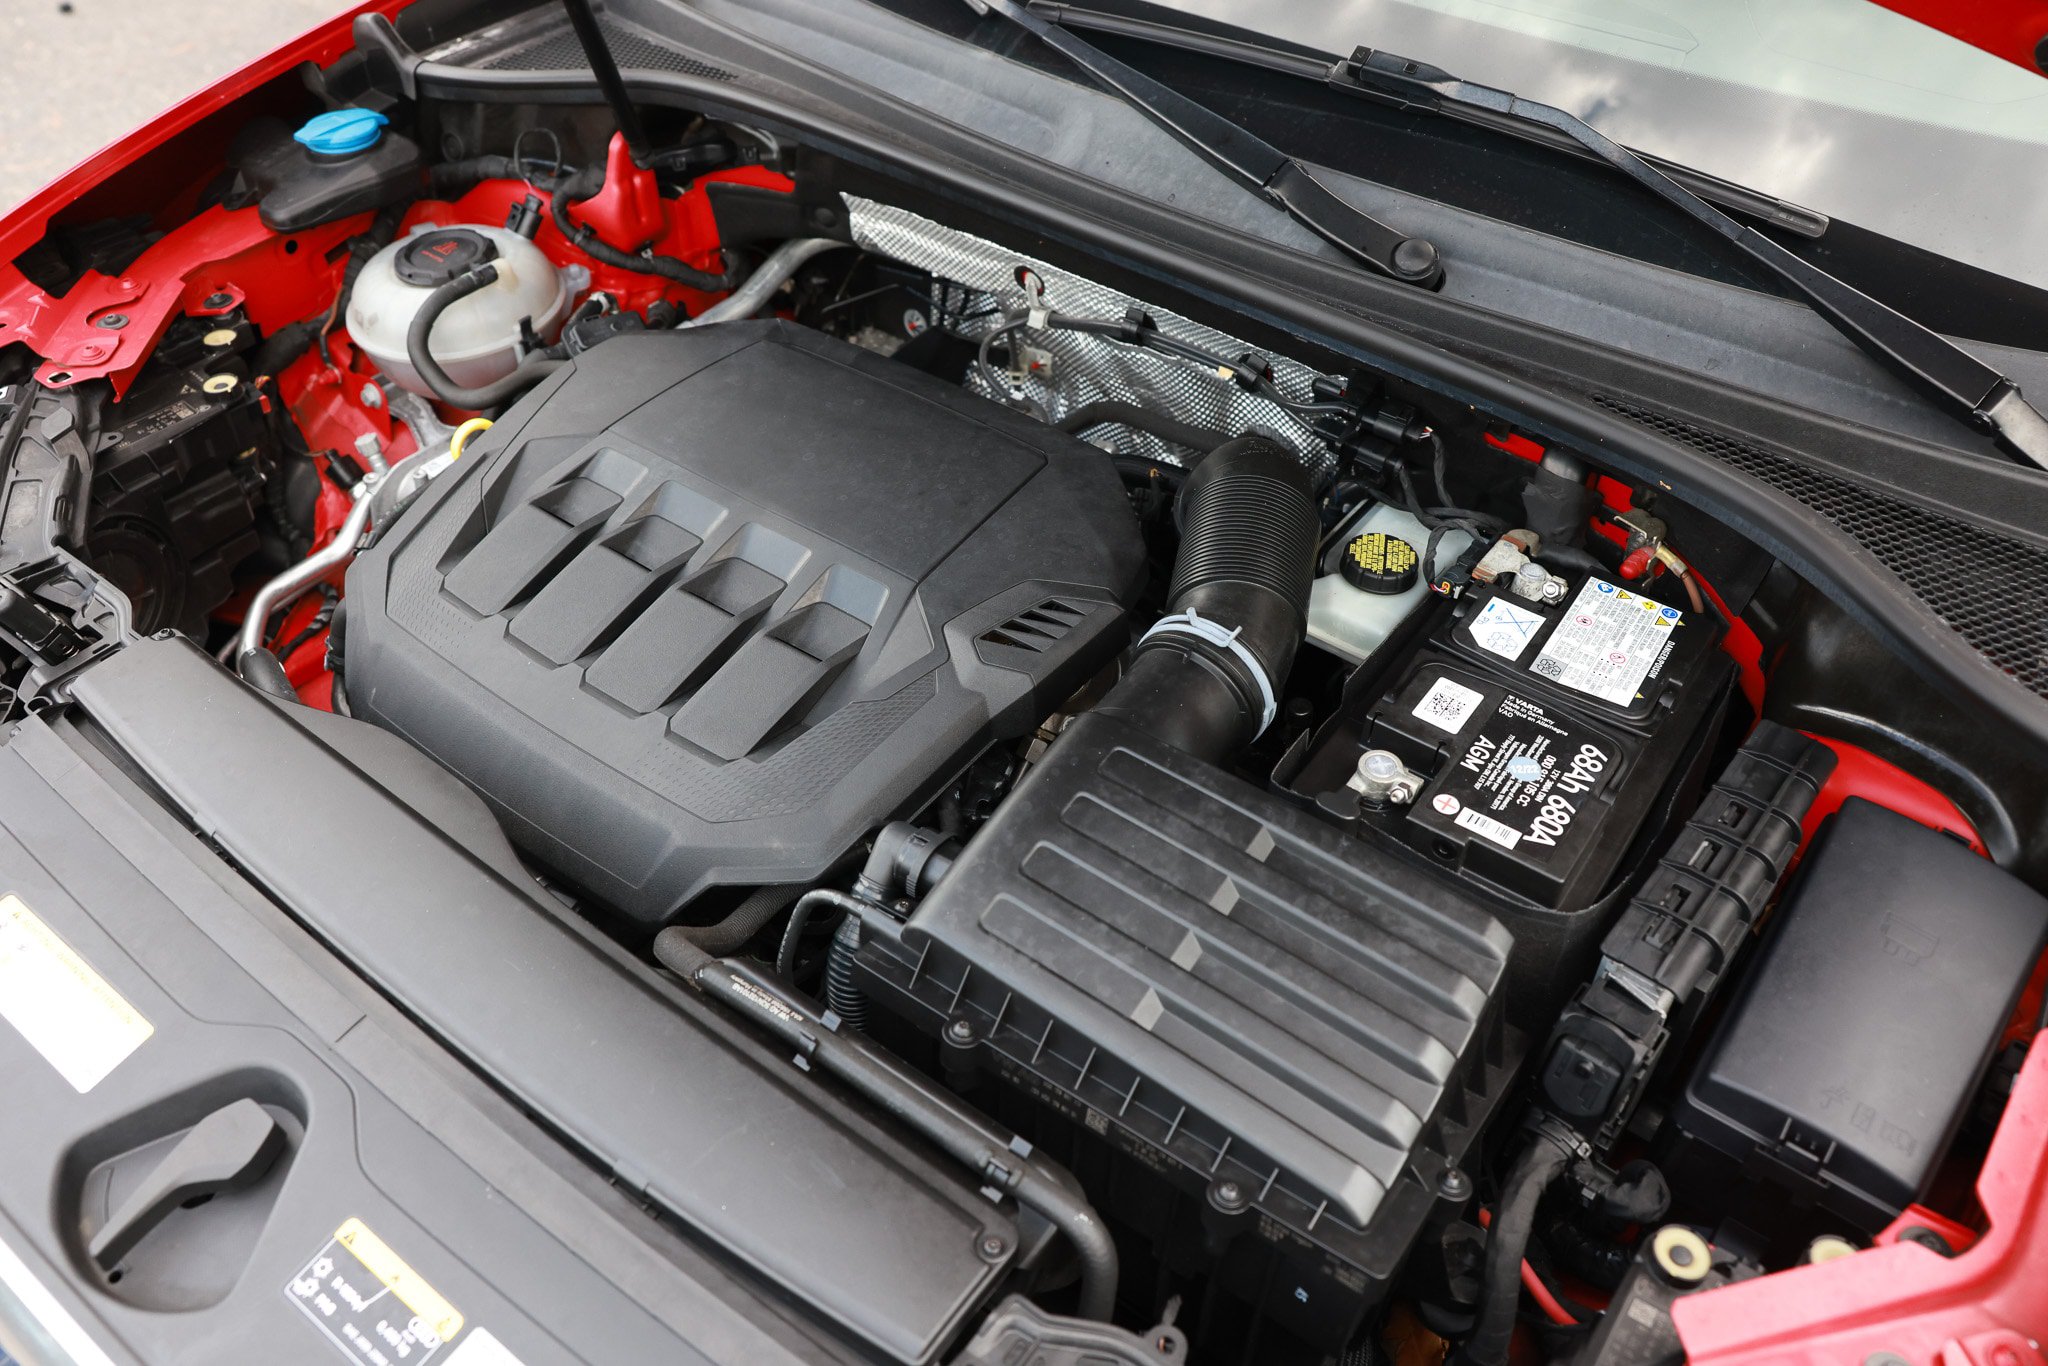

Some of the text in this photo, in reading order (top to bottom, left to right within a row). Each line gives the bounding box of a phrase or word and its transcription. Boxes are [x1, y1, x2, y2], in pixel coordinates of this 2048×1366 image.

[1647, 640, 1676, 679] DANGER/POISON
[1498, 707, 1514, 718] VAO
[1504, 699, 1520, 709] Made
[1527, 710, 1555, 725] Germany
[1515, 698, 1543, 715] VARTA
[1500, 703, 1527, 718] Fabriqué
[1535, 720, 1568, 736] Allemagne
[1460, 734, 1496, 772] AGM
[1538, 754, 1557, 769] 000
[1549, 769, 1561, 780] 12V
[1556, 744, 1608, 793] 68Ah
[1523, 779, 1540, 796] 105
[1516, 794, 1531, 807] CC
[1534, 791, 1546, 803] DIN
[1522, 794, 1576, 846] 680A
